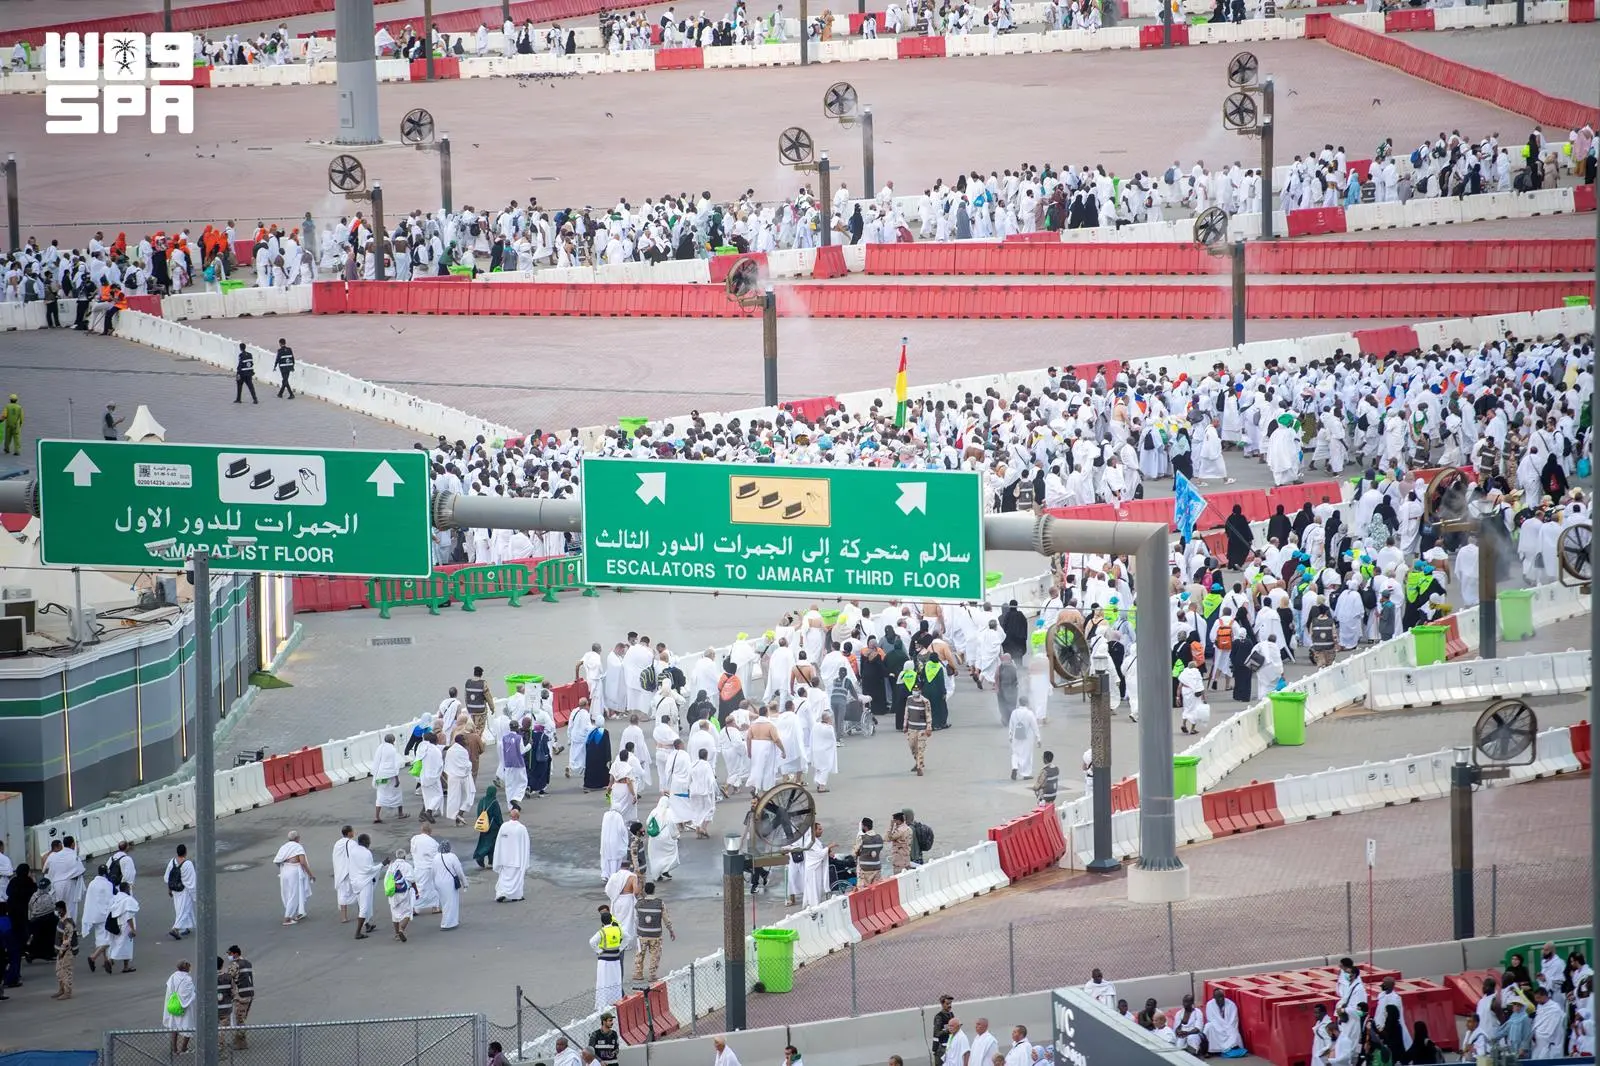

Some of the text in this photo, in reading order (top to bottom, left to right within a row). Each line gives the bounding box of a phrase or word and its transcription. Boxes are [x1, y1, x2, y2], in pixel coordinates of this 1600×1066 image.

[177, 508, 241, 536] للدور
[255, 510, 358, 539] الجمرات
[274, 546, 334, 564] FLOOR
[595, 528, 971, 569] سلالم متحركة إلى الجمرات الدور الثالث
[606, 559, 960, 589] ESCALATORS TO JAMARAT THIRD FLOOR
